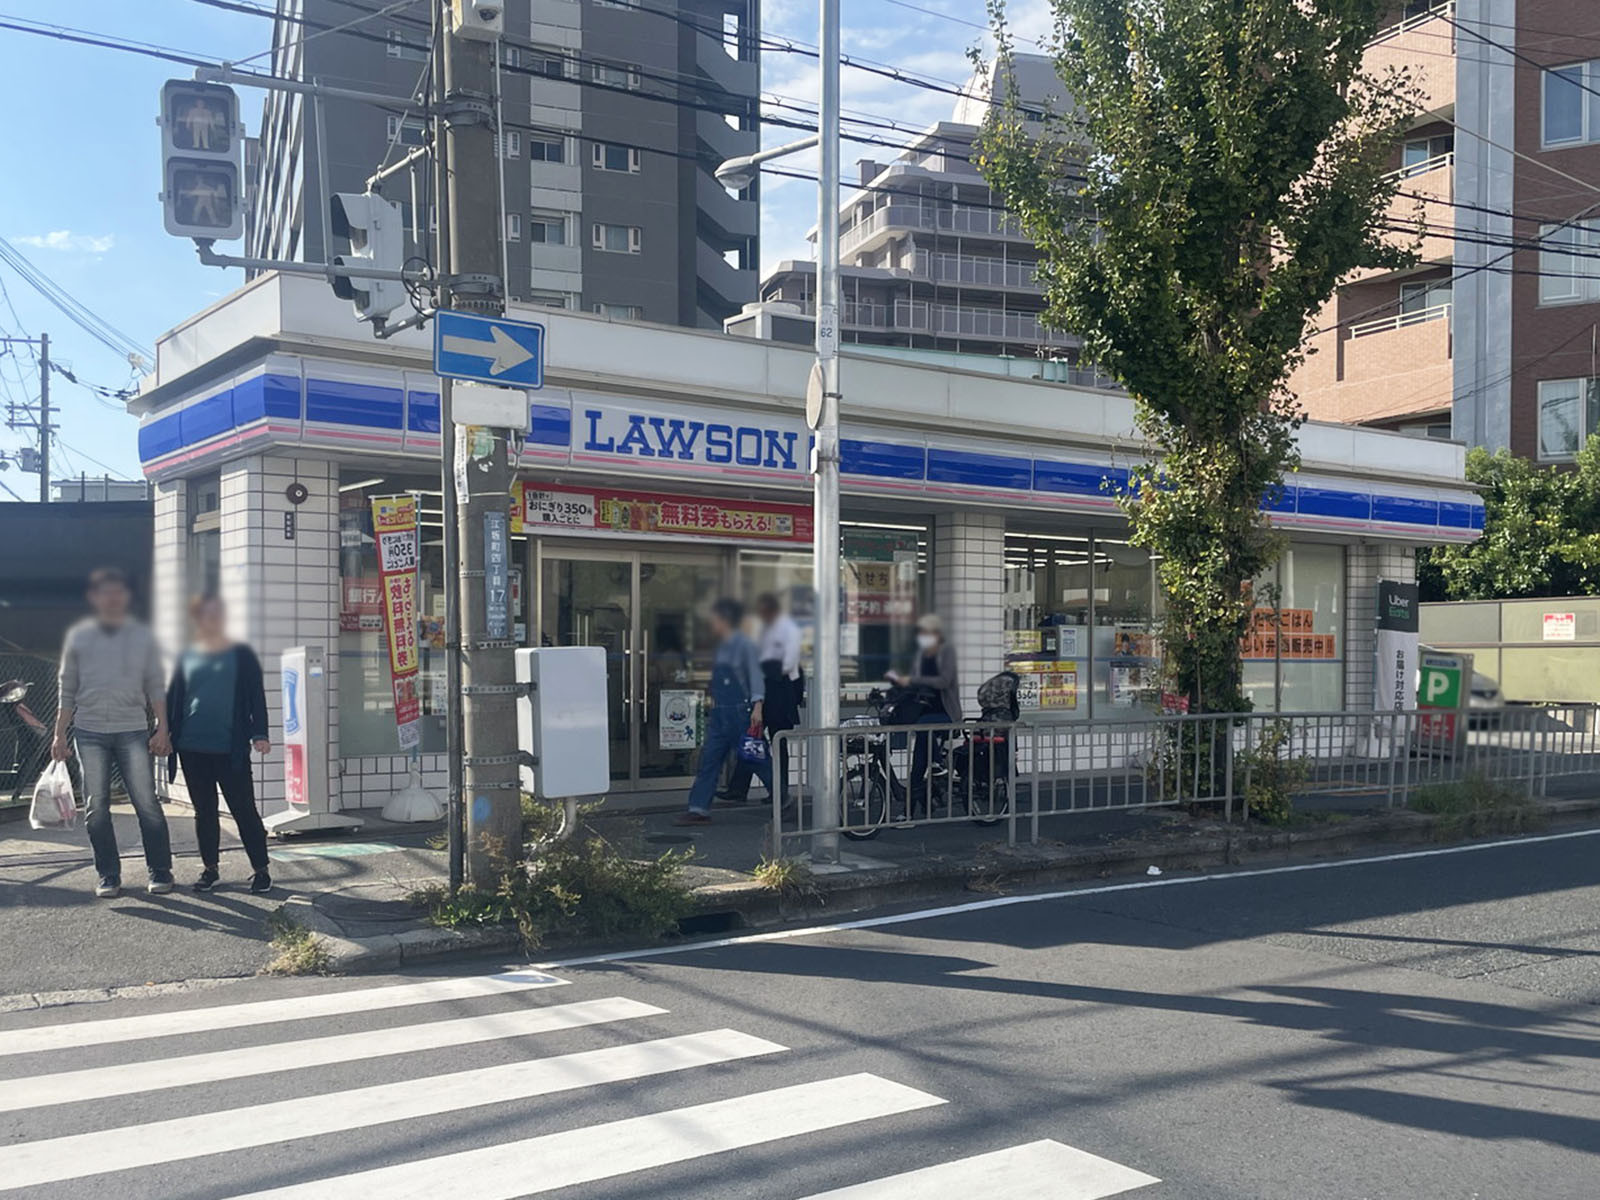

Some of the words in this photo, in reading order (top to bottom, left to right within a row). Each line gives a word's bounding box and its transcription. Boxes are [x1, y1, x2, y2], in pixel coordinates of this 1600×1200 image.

[820, 327, 833, 338] 62
[584, 409, 798, 470] LAWSON
[490, 589, 506, 602] 17
[1388, 593, 1410, 608] Uber
[1426, 671, 1450, 702] P
